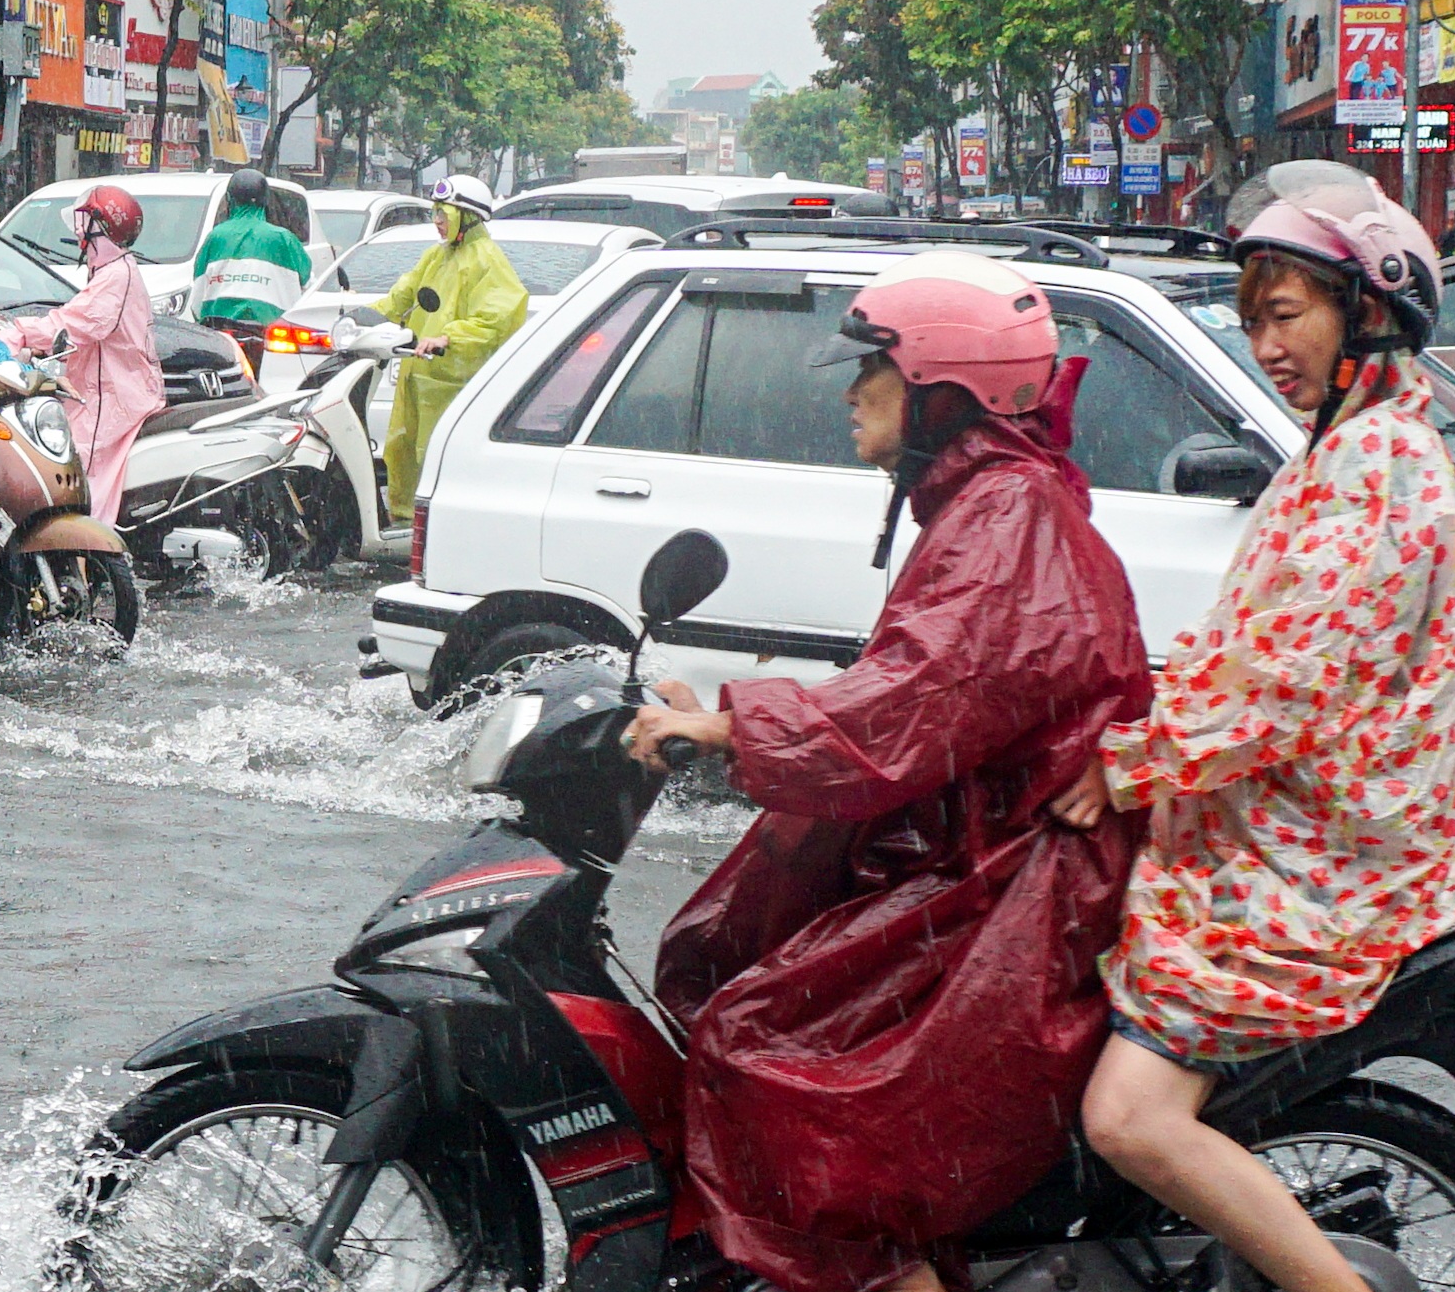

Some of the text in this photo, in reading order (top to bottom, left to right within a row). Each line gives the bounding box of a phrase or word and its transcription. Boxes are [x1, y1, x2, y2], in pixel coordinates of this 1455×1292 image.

[1356, 10, 1390, 21] POLO
[1371, 127, 1401, 139] NAM
[527, 1102, 617, 1145] YAMAHA
